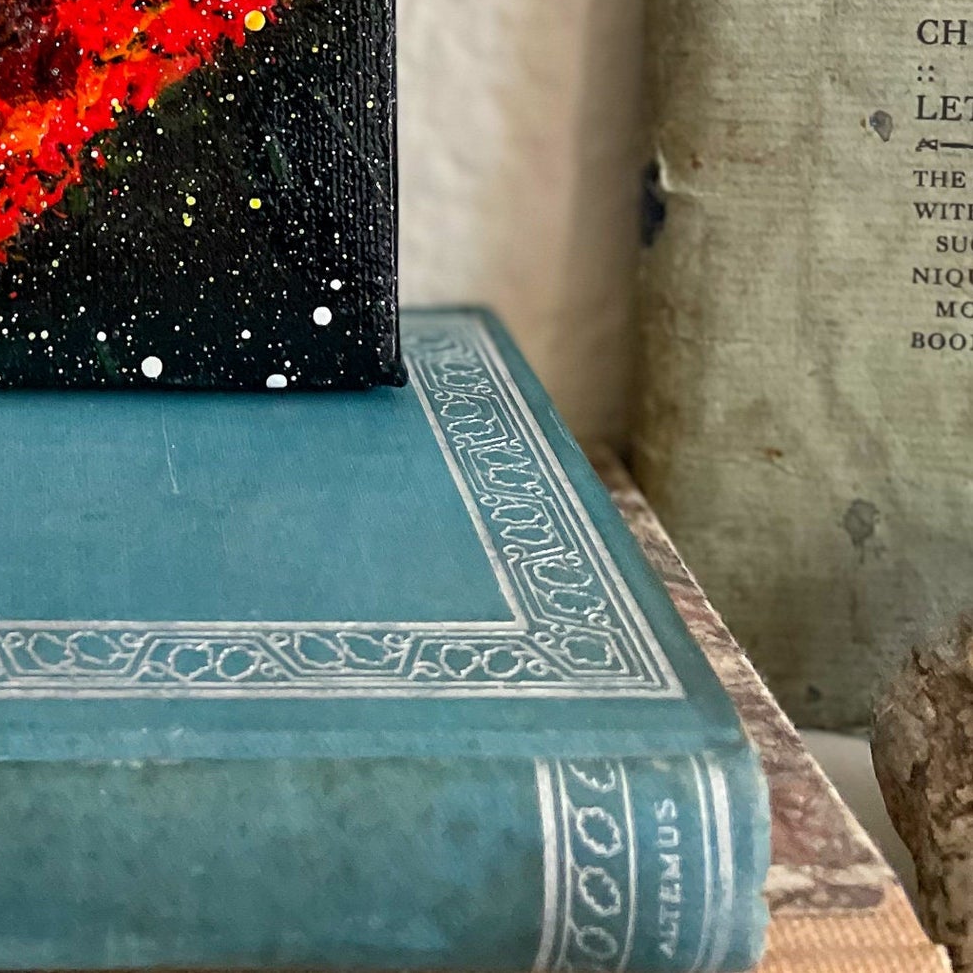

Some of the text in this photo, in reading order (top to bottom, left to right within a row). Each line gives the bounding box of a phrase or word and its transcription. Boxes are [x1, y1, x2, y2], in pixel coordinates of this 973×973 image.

[915, 18, 968, 46] CH
[913, 169, 967, 188] THE
[913, 202, 973, 220] WIT
[935, 234, 973, 254] SU
[911, 266, 973, 289] NIQ
[909, 331, 973, 351] BOO
[653, 797, 682, 960] ALTEMUS
